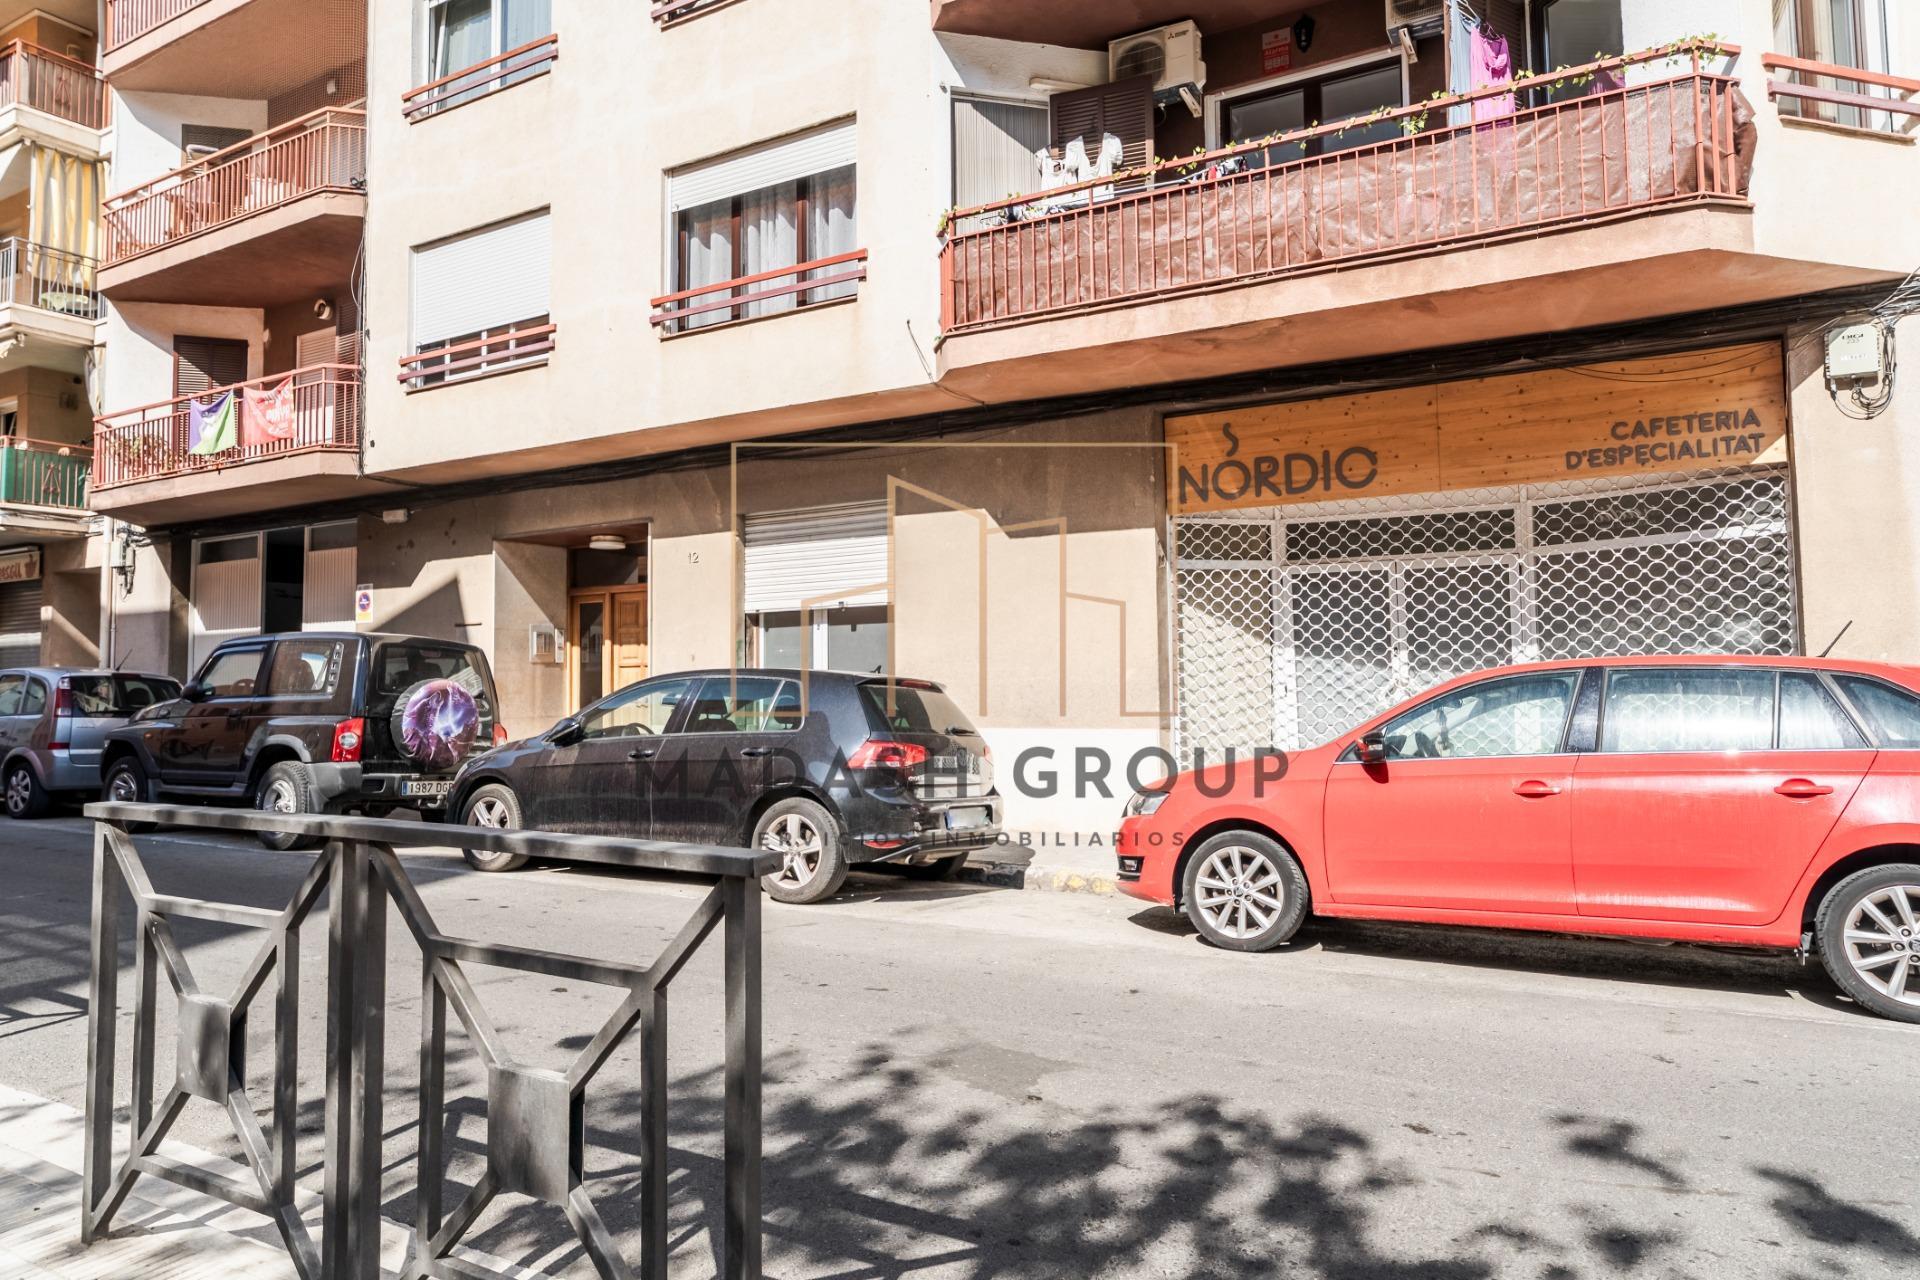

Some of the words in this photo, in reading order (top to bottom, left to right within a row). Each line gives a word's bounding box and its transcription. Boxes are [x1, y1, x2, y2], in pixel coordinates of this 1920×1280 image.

[1610, 408, 1761, 441] CAFETERIA
[1565, 432, 1765, 470] D'ESPECIALITAT
[688, 552, 700, 564] 12
[410, 782, 434, 793] 1987
